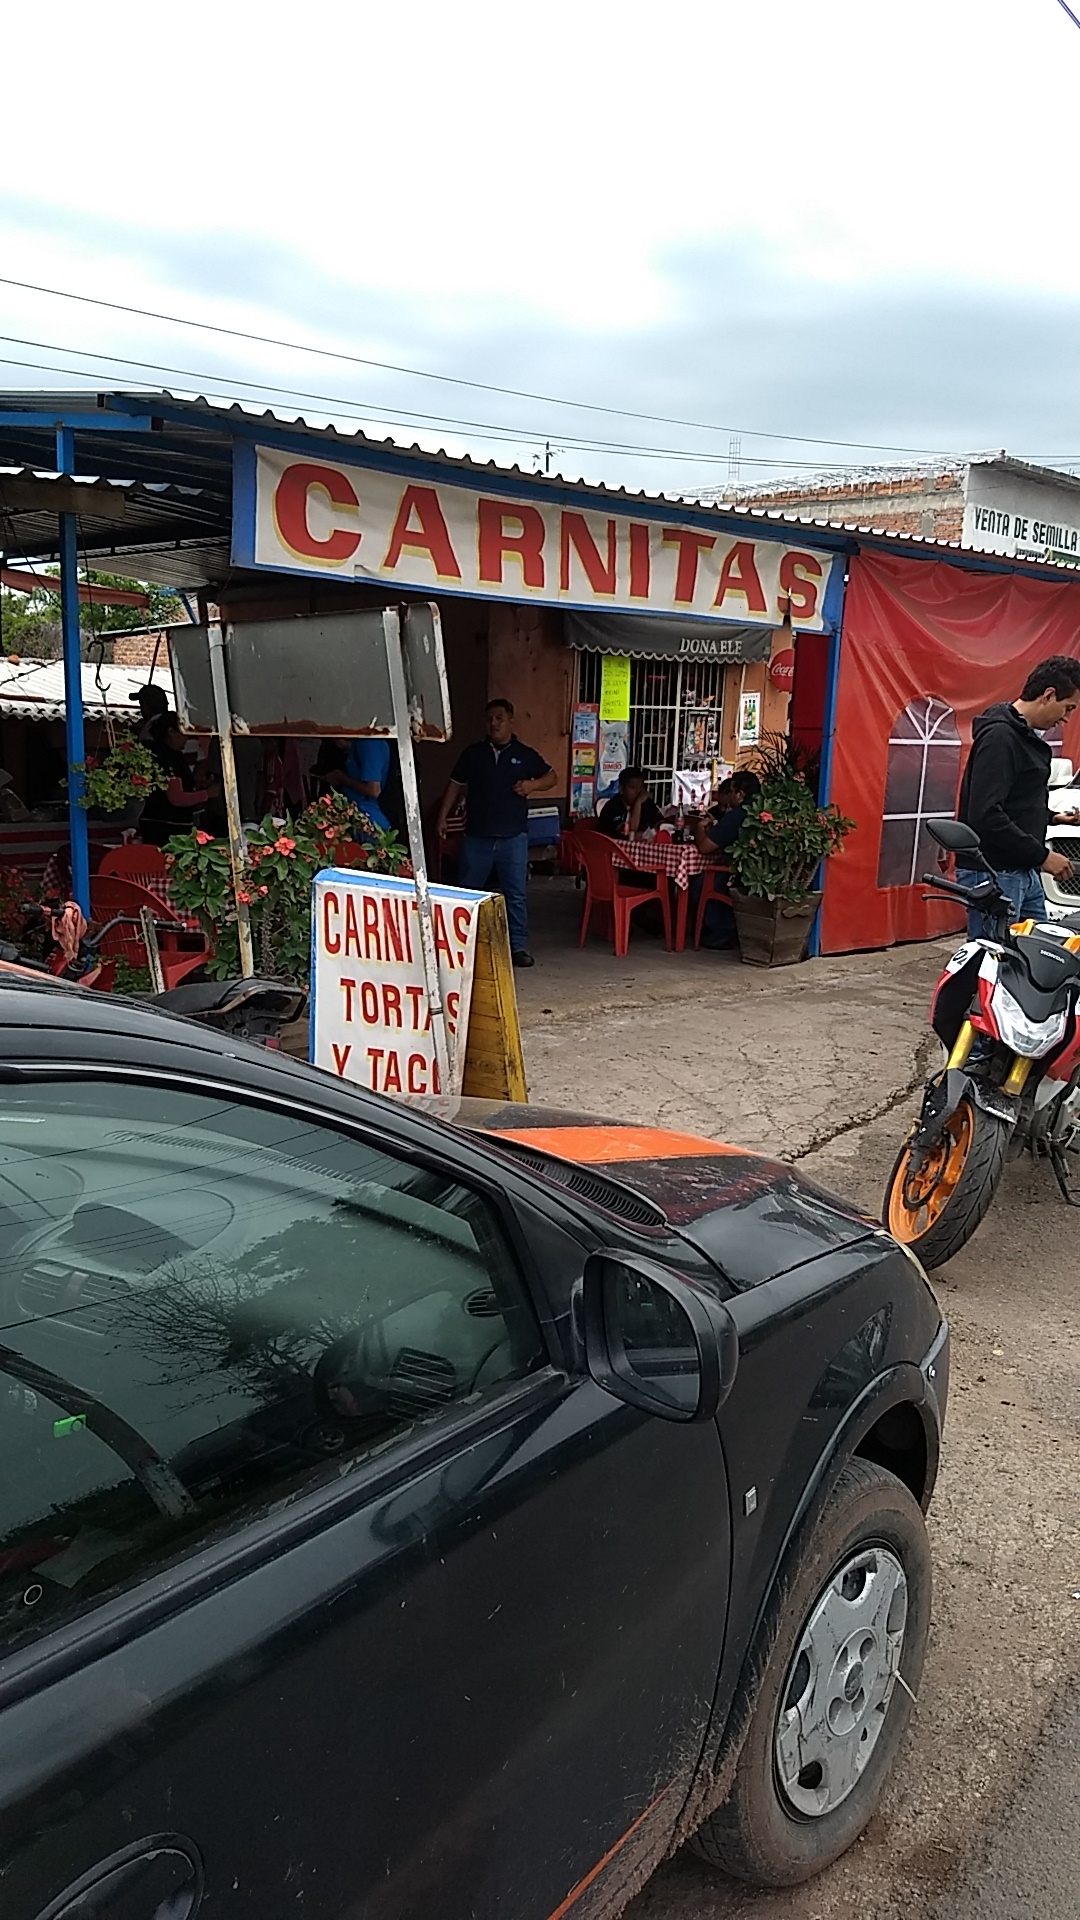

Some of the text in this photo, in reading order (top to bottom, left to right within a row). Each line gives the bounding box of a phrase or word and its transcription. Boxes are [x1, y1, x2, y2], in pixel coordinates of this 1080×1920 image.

[272, 463, 823, 620] CARNITAS
[975, 507, 1078, 552] VENTA DE SEMILLA
[1040, 949, 1065, 964] HONDA
[332, 1043, 352, 1076] Y
